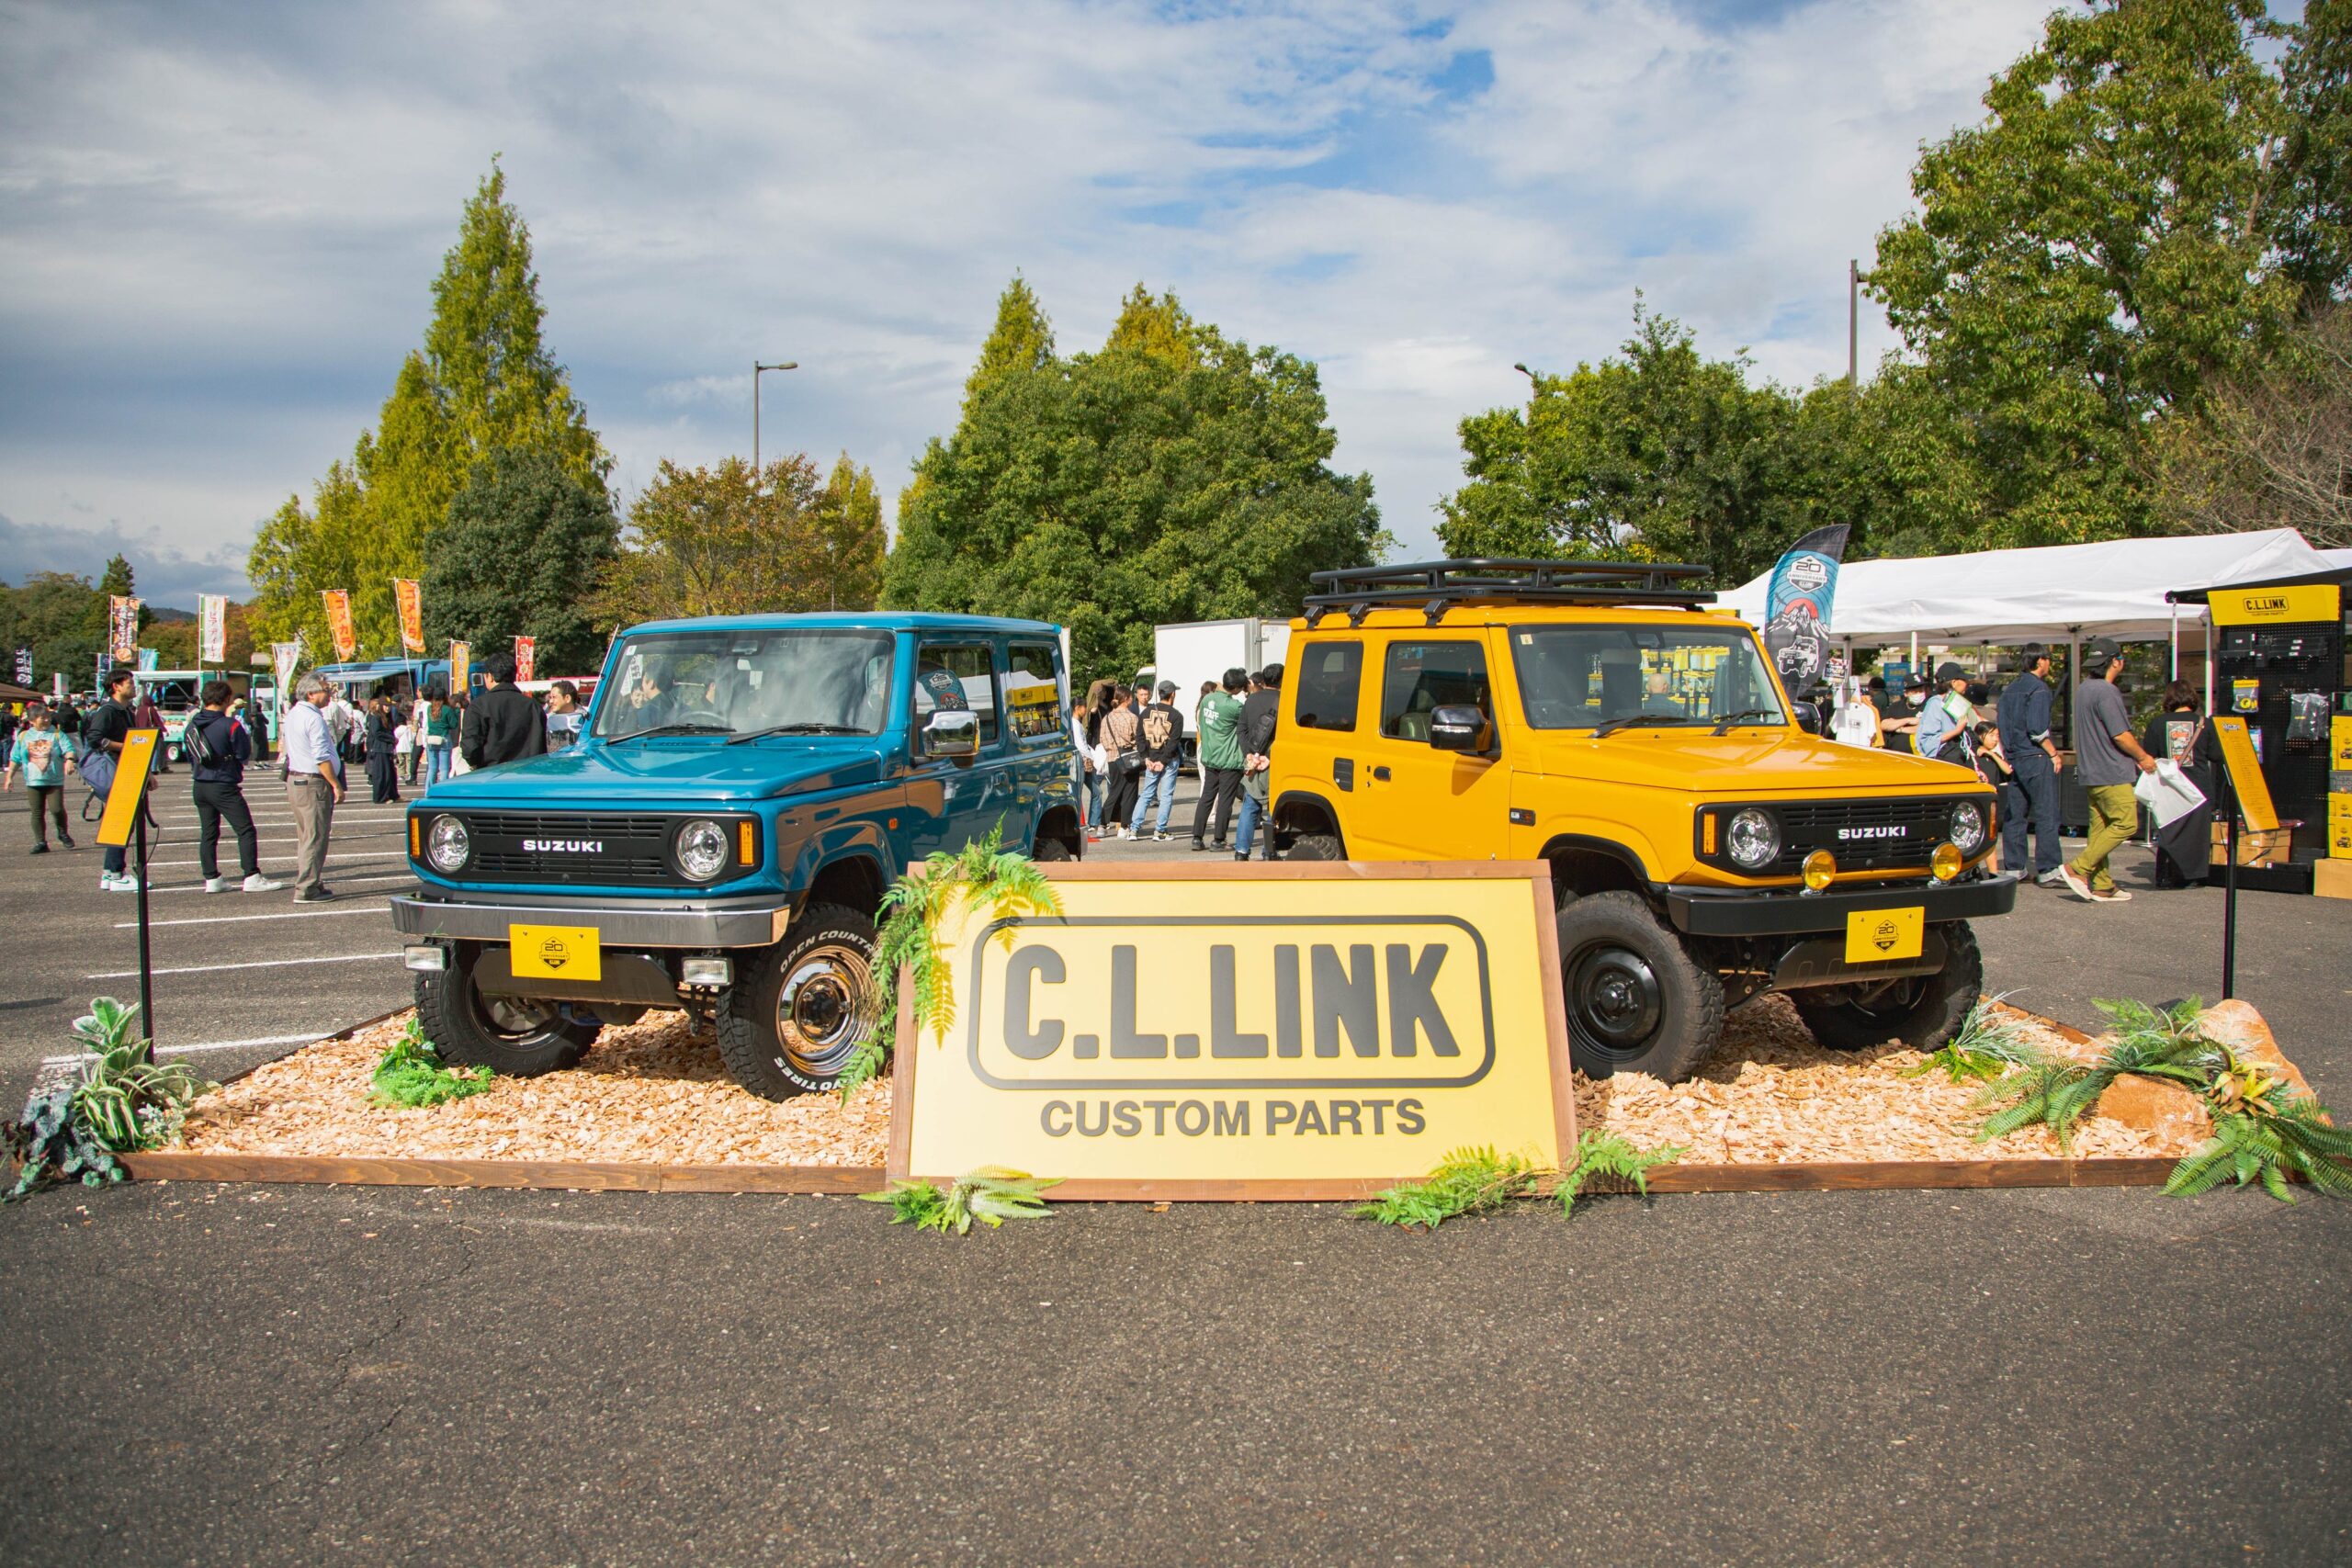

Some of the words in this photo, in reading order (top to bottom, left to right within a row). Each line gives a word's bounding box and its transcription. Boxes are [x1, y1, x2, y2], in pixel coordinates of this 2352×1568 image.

[1796, 561, 1822, 573] 20
[1788, 572, 1826, 581] ANNIVERSARY
[2245, 598, 2287, 611] C.L.LINK
[404, 589, 417, 638] コメカラ
[334, 598, 353, 649] コメカラ
[1204, 707, 1219, 720] STAFF
[1838, 826, 1906, 840] SUZUKI
[523, 840, 603, 852] SUZUKI
[1878, 925, 1894, 935] 20
[545, 942, 563, 952] 20
[780, 936, 816, 973] OPEN
[818, 930, 874, 956] COUNTR
[1002, 943, 1461, 1060] C.L.LINK
[774, 1056, 817, 1090] TIRES
[1039, 1099, 1251, 1138] CUSTOM
[1265, 1098, 1427, 1136] PARTS
